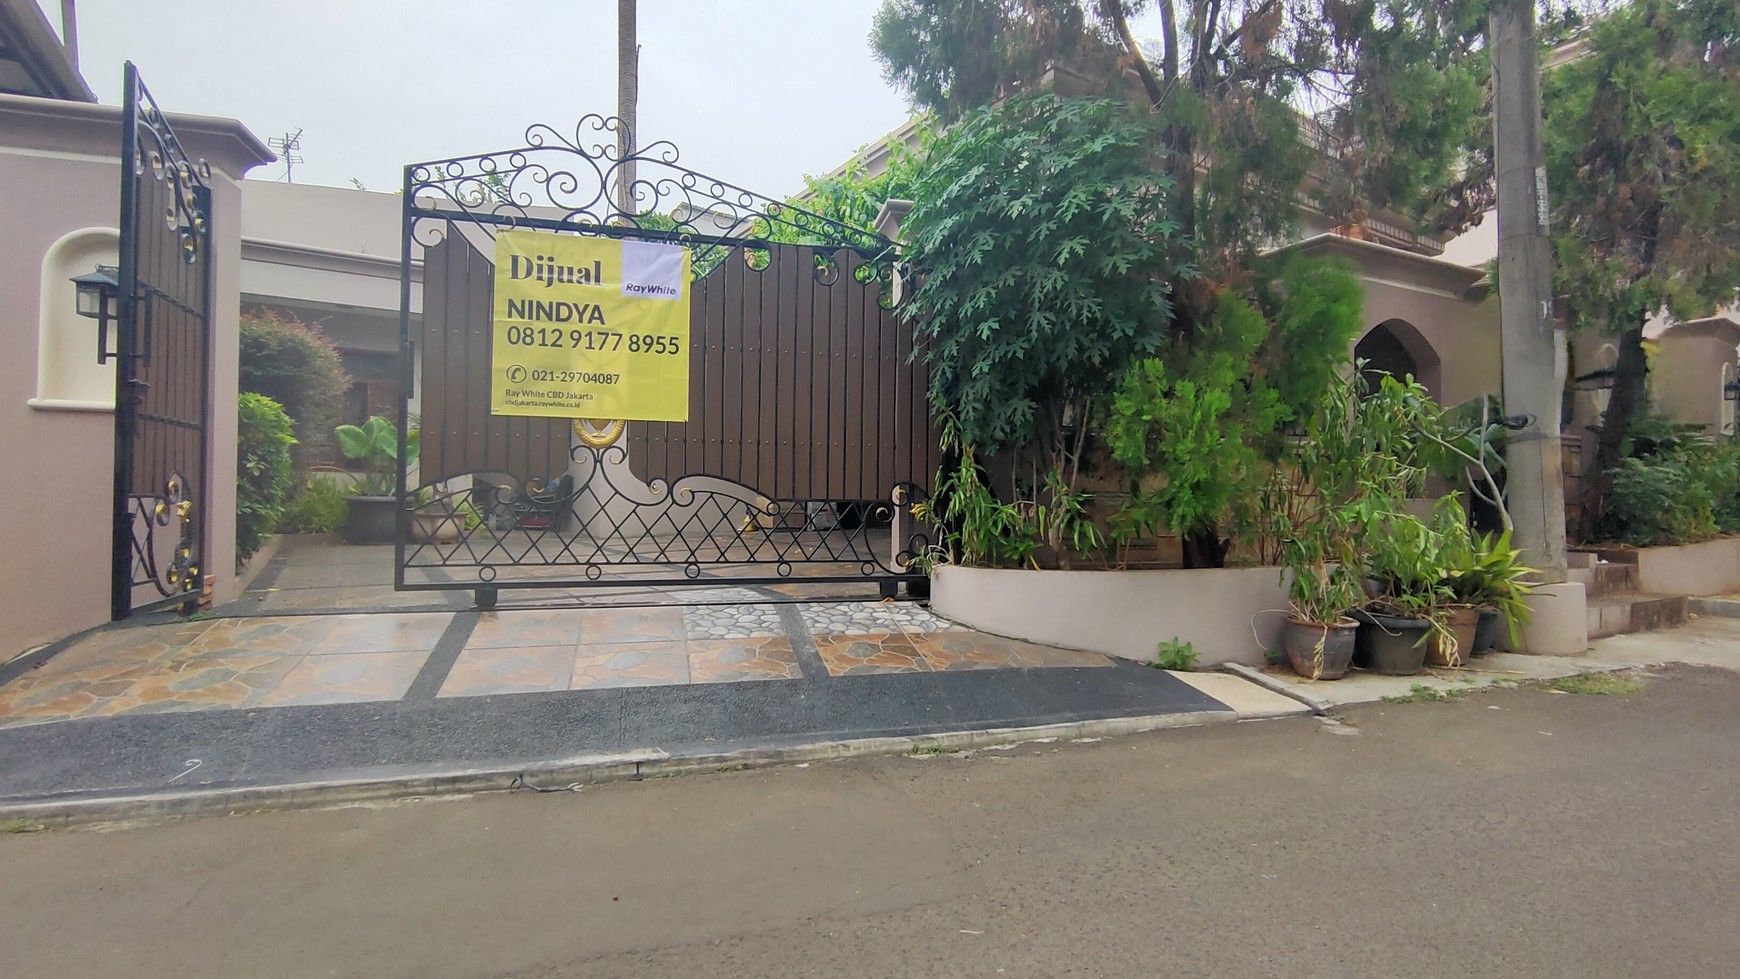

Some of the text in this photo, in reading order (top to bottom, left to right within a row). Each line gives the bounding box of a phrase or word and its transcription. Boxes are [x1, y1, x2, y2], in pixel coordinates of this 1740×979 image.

[509, 254, 602, 287] Dijual
[625, 282, 677, 296] RayWhite
[507, 298, 606, 325] NINDYA
[507, 326, 680, 355] 0812 9177 8955
[532, 369, 620, 385] 021-29704087
[505, 389, 594, 401] Ray White CBD Jakarta
[505, 400, 580, 408] cbdjakarta.raywhite.co.id
